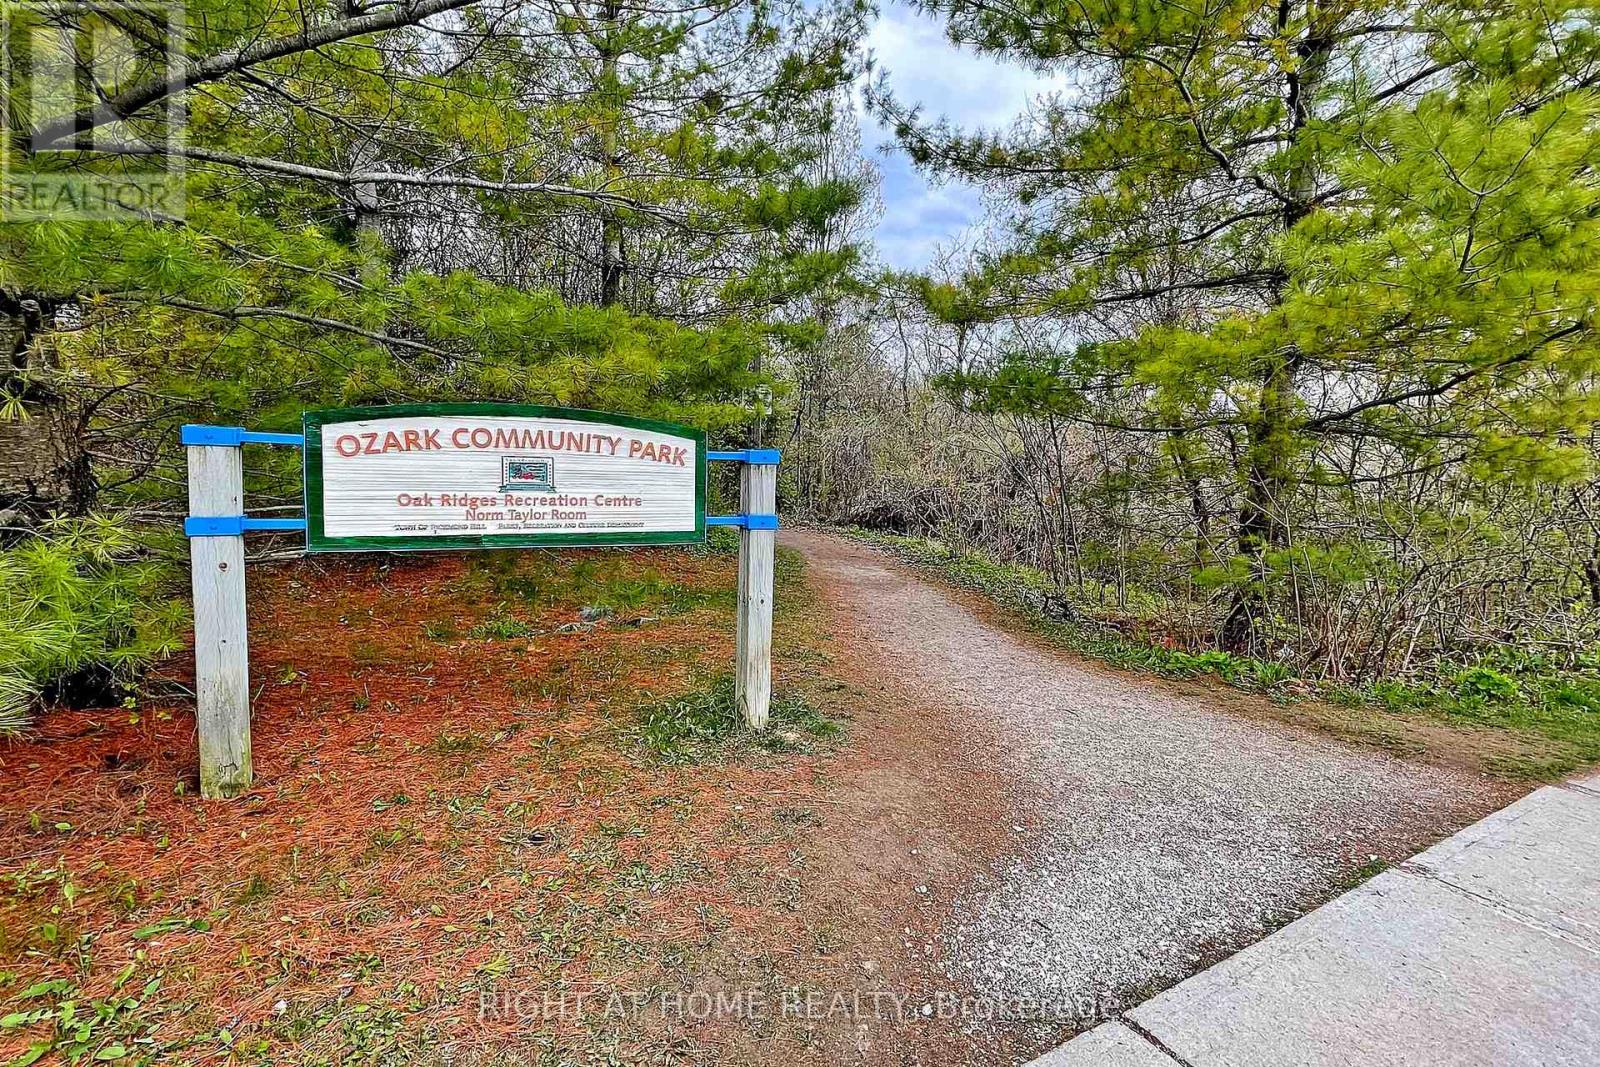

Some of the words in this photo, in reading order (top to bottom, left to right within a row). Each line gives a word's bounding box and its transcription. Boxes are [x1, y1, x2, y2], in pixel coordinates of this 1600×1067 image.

[335, 428, 442, 458] OZARK
[452, 427, 622, 456] COMMUNITY
[630, 439, 688, 467] PARK
[397, 492, 432, 507] Oak
[440, 493, 497, 509] Ridges
[504, 494, 588, 507] Recreation
[594, 495, 643, 507] Centre
[465, 509, 504, 521] Norm
[507, 508, 548, 523] Taylor
[551, 509, 588, 521] Room
